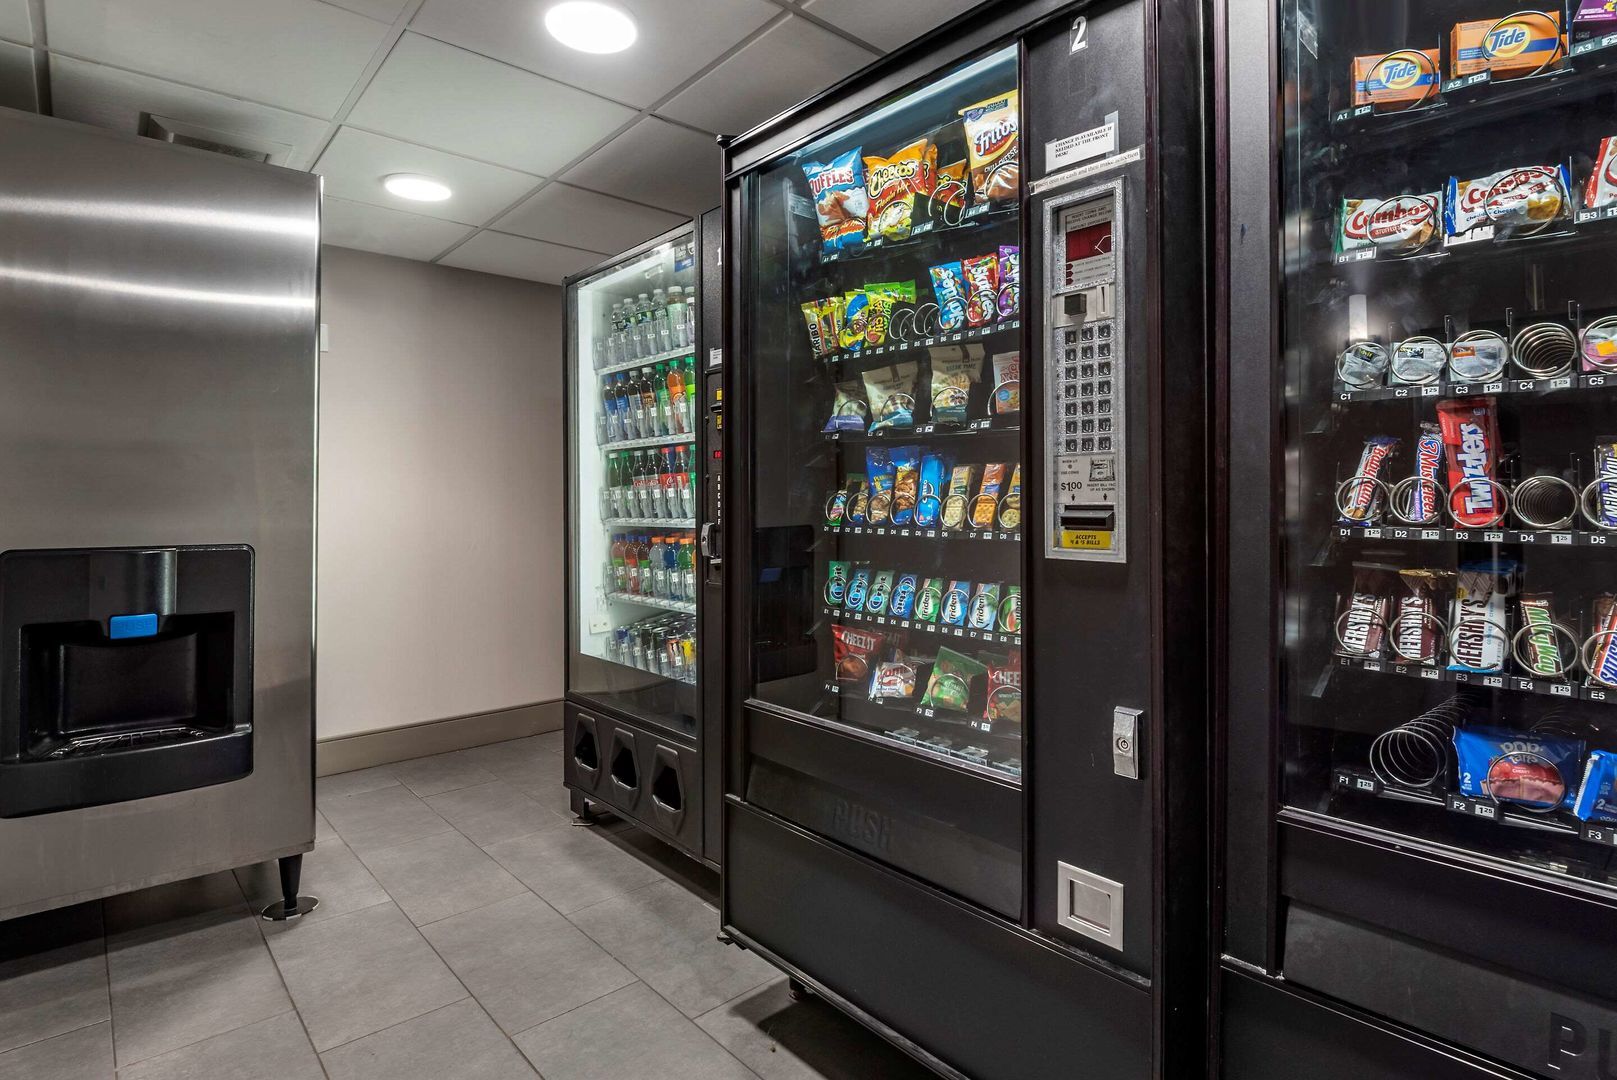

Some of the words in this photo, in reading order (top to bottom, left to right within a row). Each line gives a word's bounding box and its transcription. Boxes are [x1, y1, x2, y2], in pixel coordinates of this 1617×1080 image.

[1071, 15, 1087, 52] 2
[1489, 27, 1527, 54] Tide
[1577, 45, 1592, 54] A3
[1384, 62, 1417, 86] Tide
[1447, 80, 1461, 89] A2
[1337, 113, 1348, 121] A1
[1080, 128, 1106, 140] AVAILABLE
[1092, 132, 1109, 142] FRONT
[869, 160, 916, 199] Cheetos
[1352, 200, 1431, 230] Combos
[1584, 211, 1597, 219] B3
[1519, 382, 1533, 390] C4
[1589, 377, 1604, 385] C5
[1395, 389, 1408, 397] C2
[1455, 386, 1468, 394] C3
[1419, 439, 1441, 454] 3
[1600, 456, 1617, 482] Way
[1419, 451, 1440, 521] Musketeers
[1602, 482, 1617, 518] Milky
[1455, 532, 1469, 540] D3
[1520, 534, 1535, 542] D4
[1590, 536, 1606, 544] D5
[949, 591, 958, 620] Trident
[977, 594, 985, 625] Trident
[1520, 681, 1533, 690] E4
[1591, 691, 1605, 700] E5
[1339, 776, 1349, 785] F1
[1463, 772, 1472, 784] 2
[1453, 801, 1466, 811] F2
[1595, 798, 1606, 809] 2
[1588, 831, 1602, 840] F3
